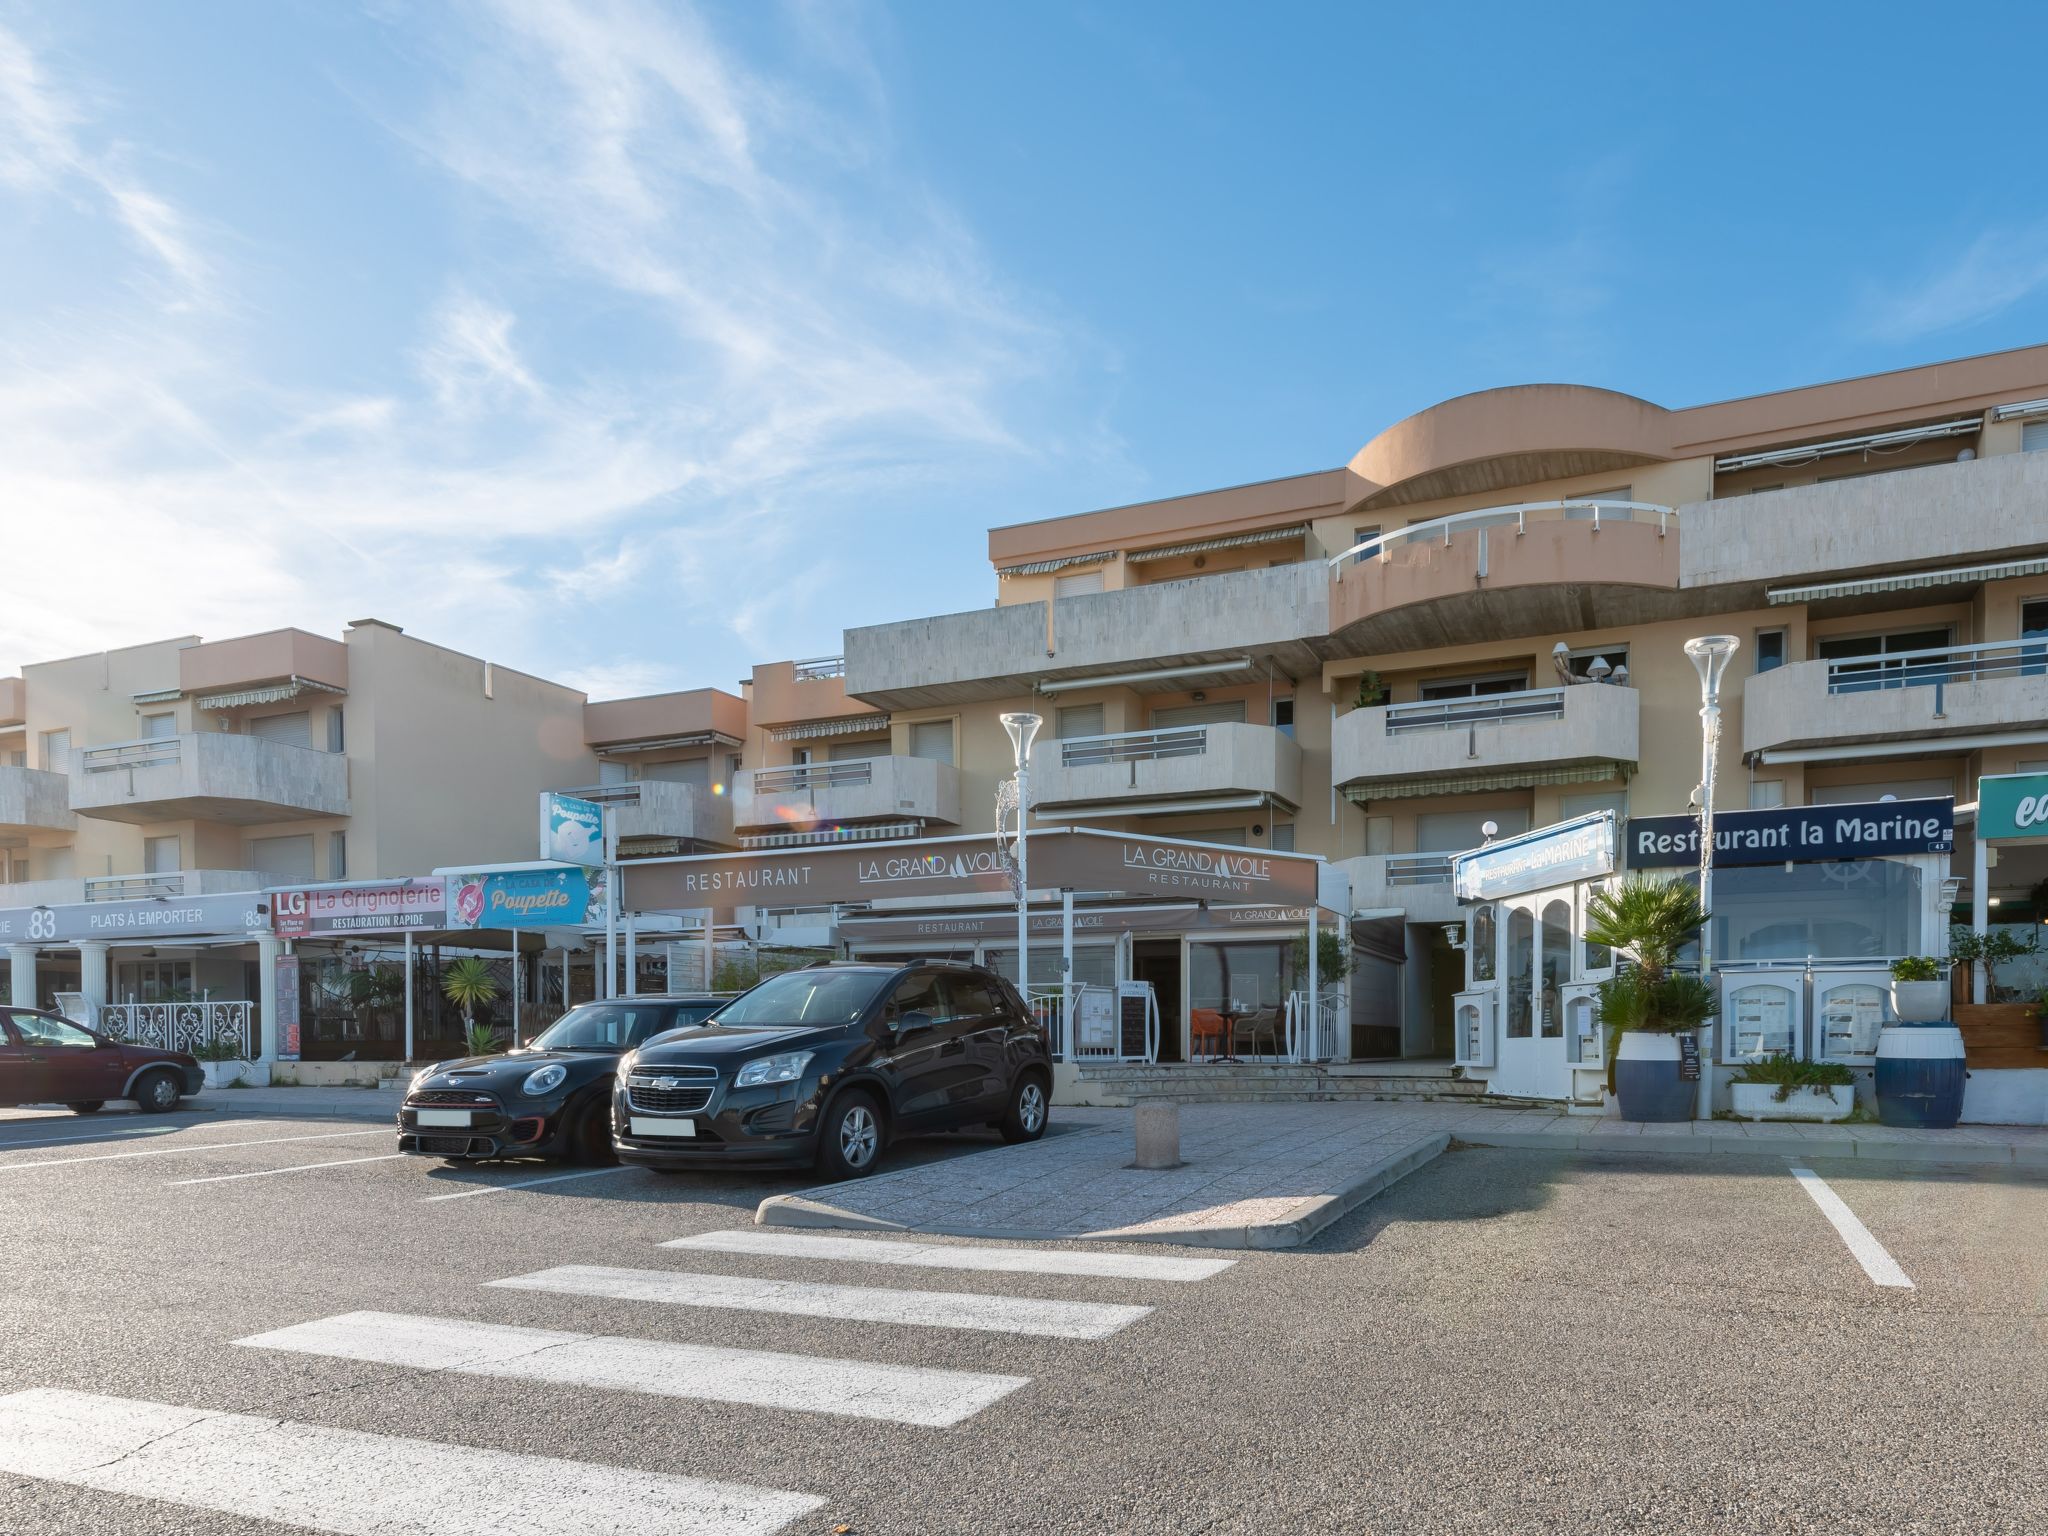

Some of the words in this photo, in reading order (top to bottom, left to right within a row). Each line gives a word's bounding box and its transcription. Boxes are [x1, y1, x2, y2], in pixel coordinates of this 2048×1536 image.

[551, 804, 599, 824] Poupette
[1638, 824, 1790, 854] Resturant
[1801, 821, 1824, 845] la
[1836, 815, 1940, 843] Marine
[1124, 844, 1146, 865] LA
[1152, 848, 1212, 871] GRAND
[1228, 855, 1271, 878] VOILE
[1544, 836, 1590, 867] MARINE
[686, 866, 812, 892] RESTAURANT
[858, 861, 880, 880] LA
[886, 855, 946, 877] GRAND
[965, 851, 1004, 872] VOIL
[1149, 873, 1250, 891] RESTAURANT
[276, 892, 306, 916] LG
[316, 891, 336, 910] La
[341, 885, 441, 912] Grignoterie
[491, 889, 570, 915] Poupette
[30, 909, 56, 939] 83
[90, 912, 126, 929] PLATS
[127, 909, 136, 926] À
[138, 908, 203, 927] EMPORTER
[332, 915, 391, 930] RESTAURATION
[393, 913, 424, 926] RAPIDE
[918, 921, 985, 934] RESTAURANT
[1032, 918, 1043, 928] LA
[1045, 916, 1065, 927] GRA
[1230, 911, 1242, 921] LA
[1244, 909, 1277, 921] GRAND
